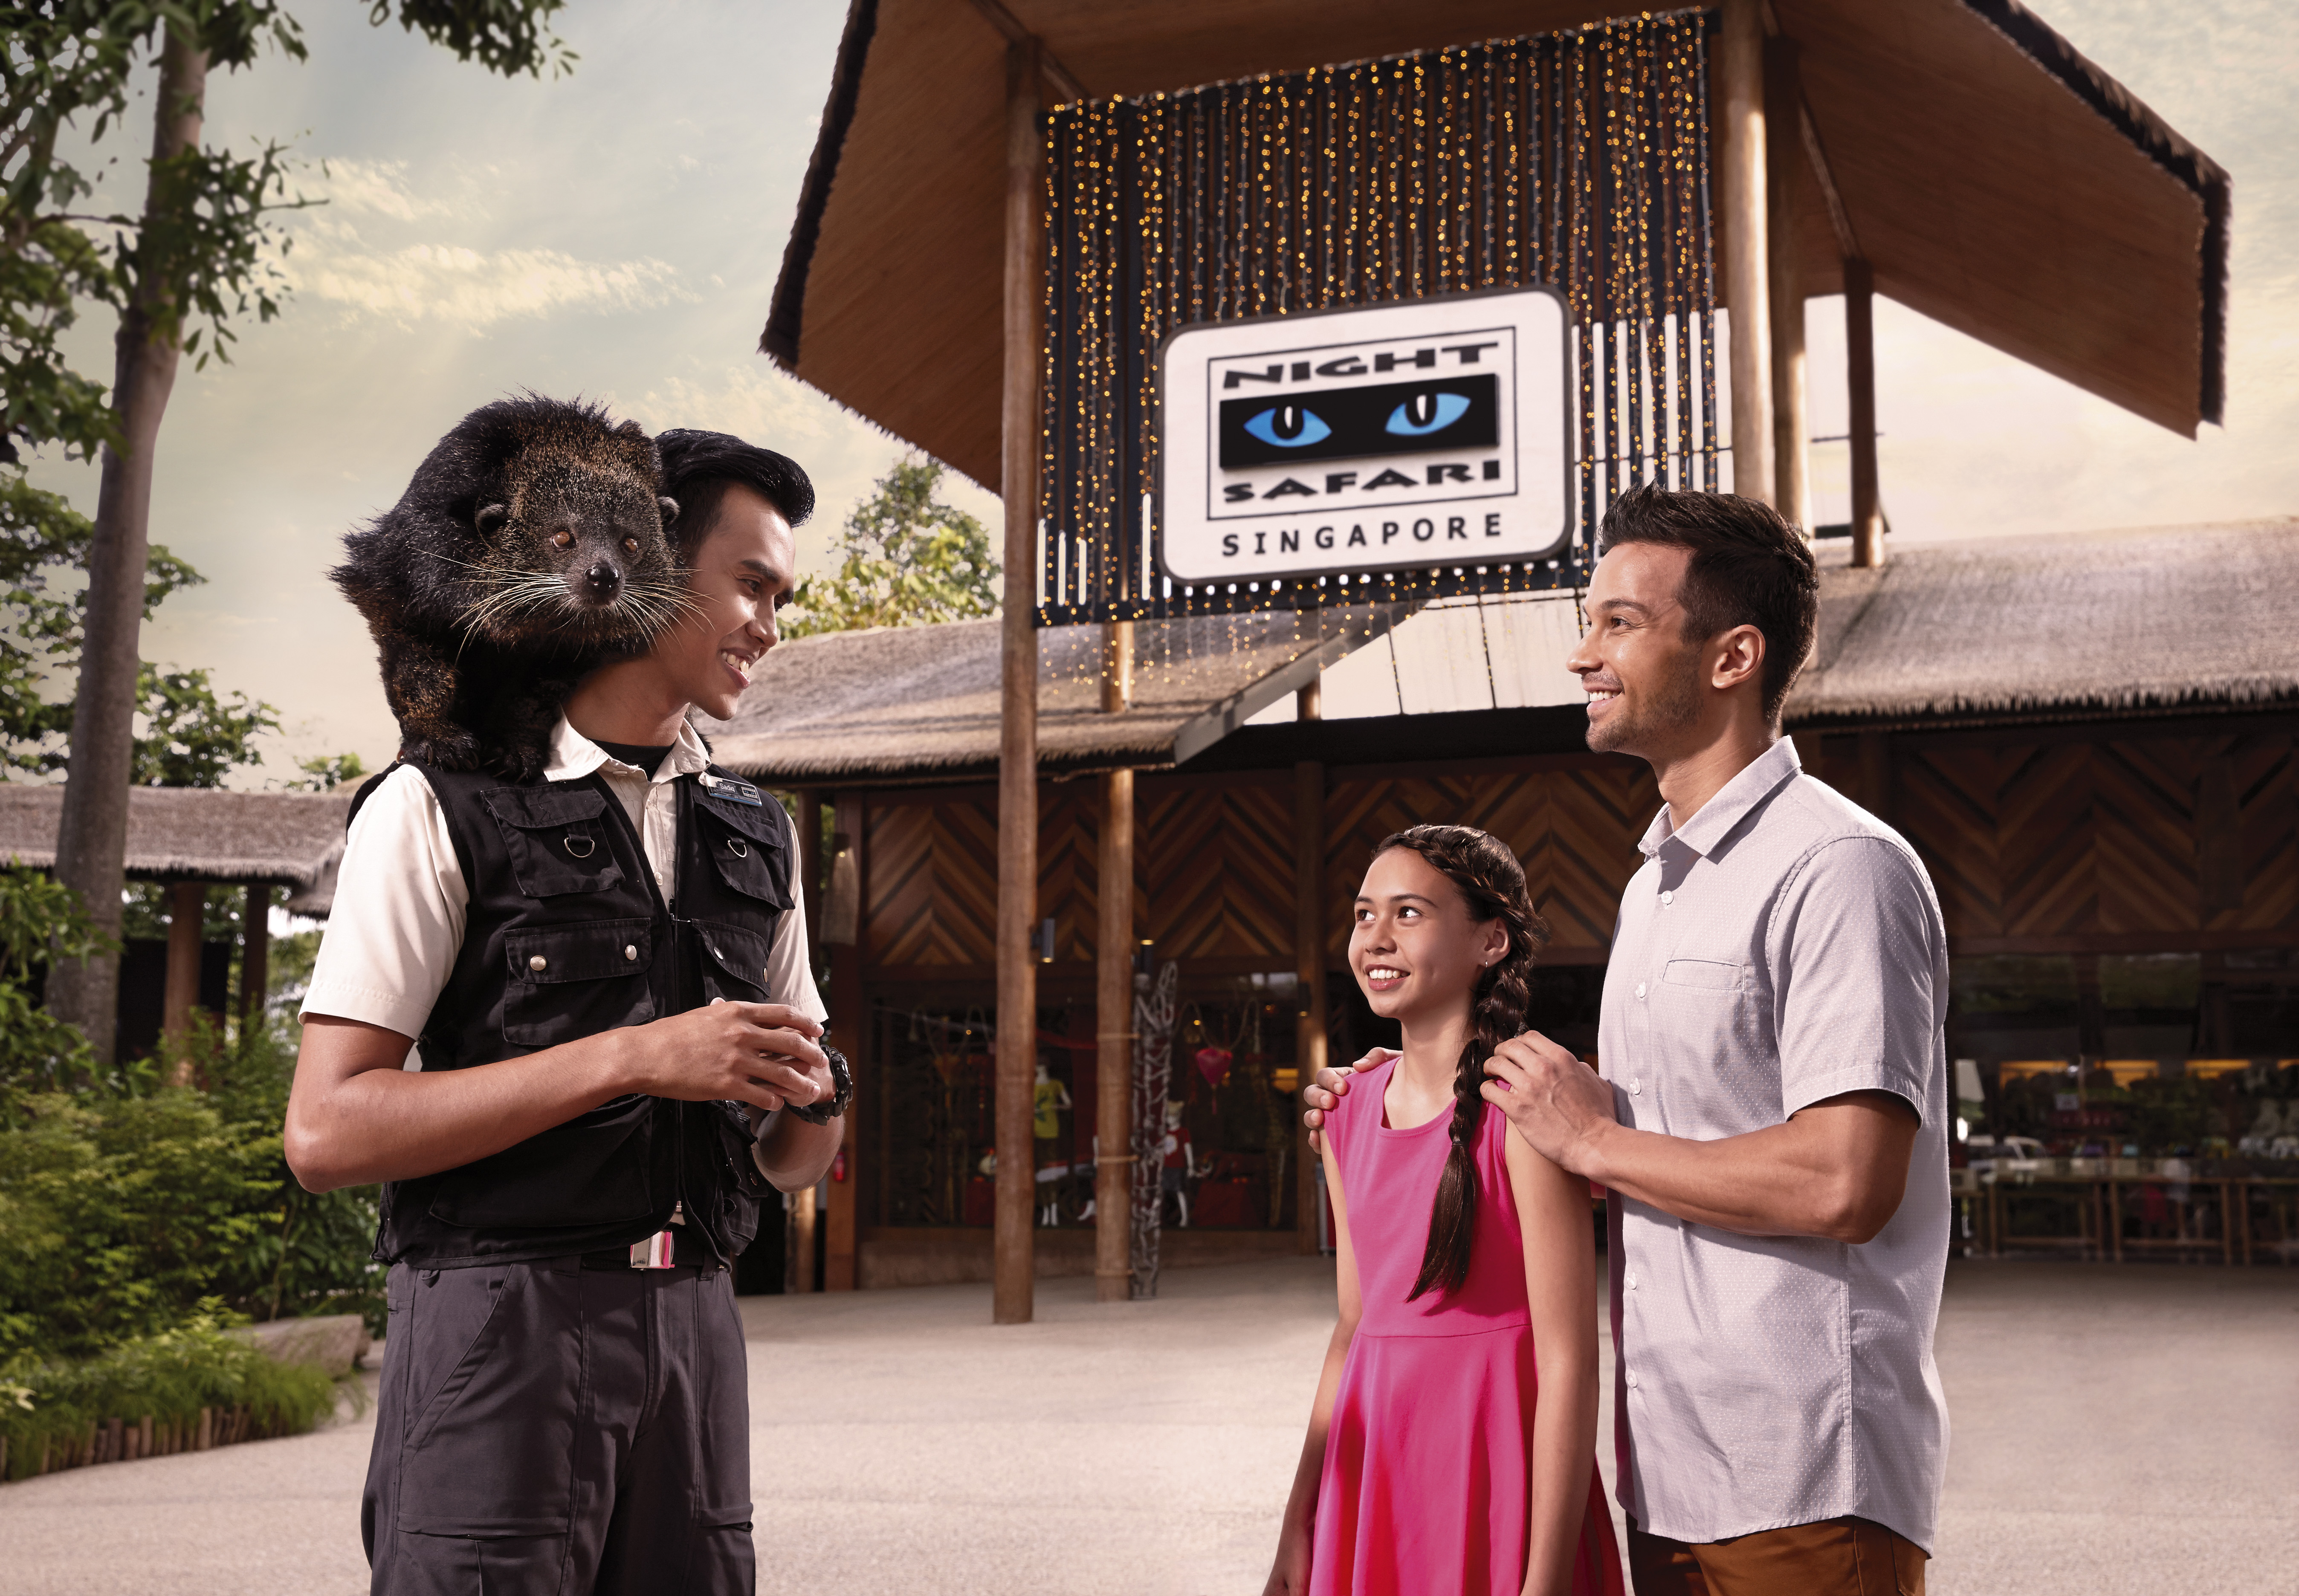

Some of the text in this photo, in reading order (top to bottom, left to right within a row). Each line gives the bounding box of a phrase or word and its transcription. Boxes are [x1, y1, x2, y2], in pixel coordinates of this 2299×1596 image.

[1223, 342, 1499, 389] NIGHT
[1223, 460, 1500, 503] SAFARI
[1222, 513, 1501, 556] SINGAPORE
[719, 783, 735, 792] Sadiq
